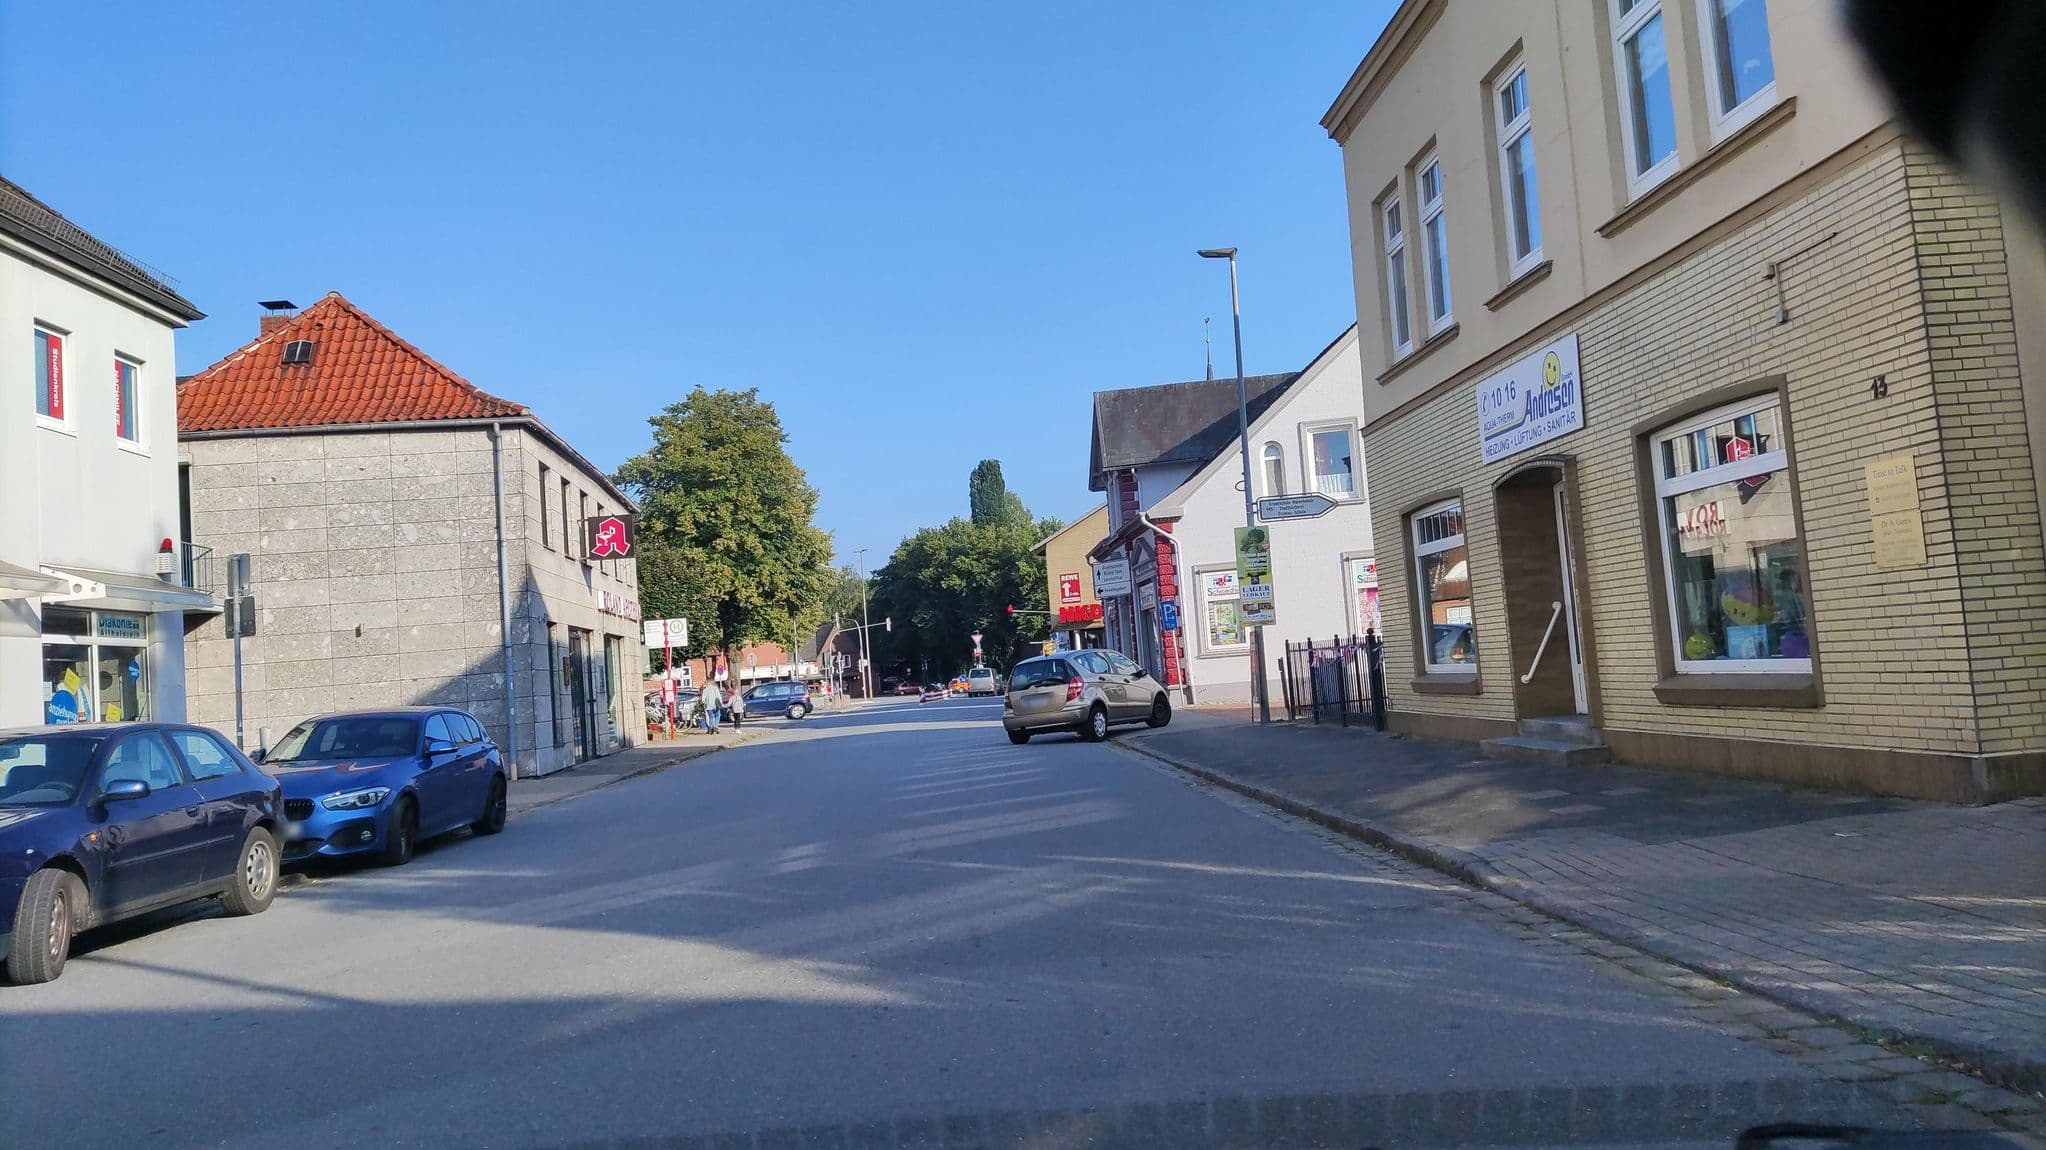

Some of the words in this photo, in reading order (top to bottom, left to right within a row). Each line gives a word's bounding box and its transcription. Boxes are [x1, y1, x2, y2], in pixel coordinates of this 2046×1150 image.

[1491, 387, 1502, 408] 10
[1504, 380, 1516, 402] 16
[1525, 379, 1574, 422] Andresen
[1871, 374, 1888, 400] 13
[1484, 411, 1515, 432] AQUA-THERM
[1485, 438, 1510, 457] HEIZUNG
[1514, 425, 1543, 446] LÜFTUNG
[1547, 410, 1577, 433] SANITÄR
[1059, 603, 1103, 623] NKD
